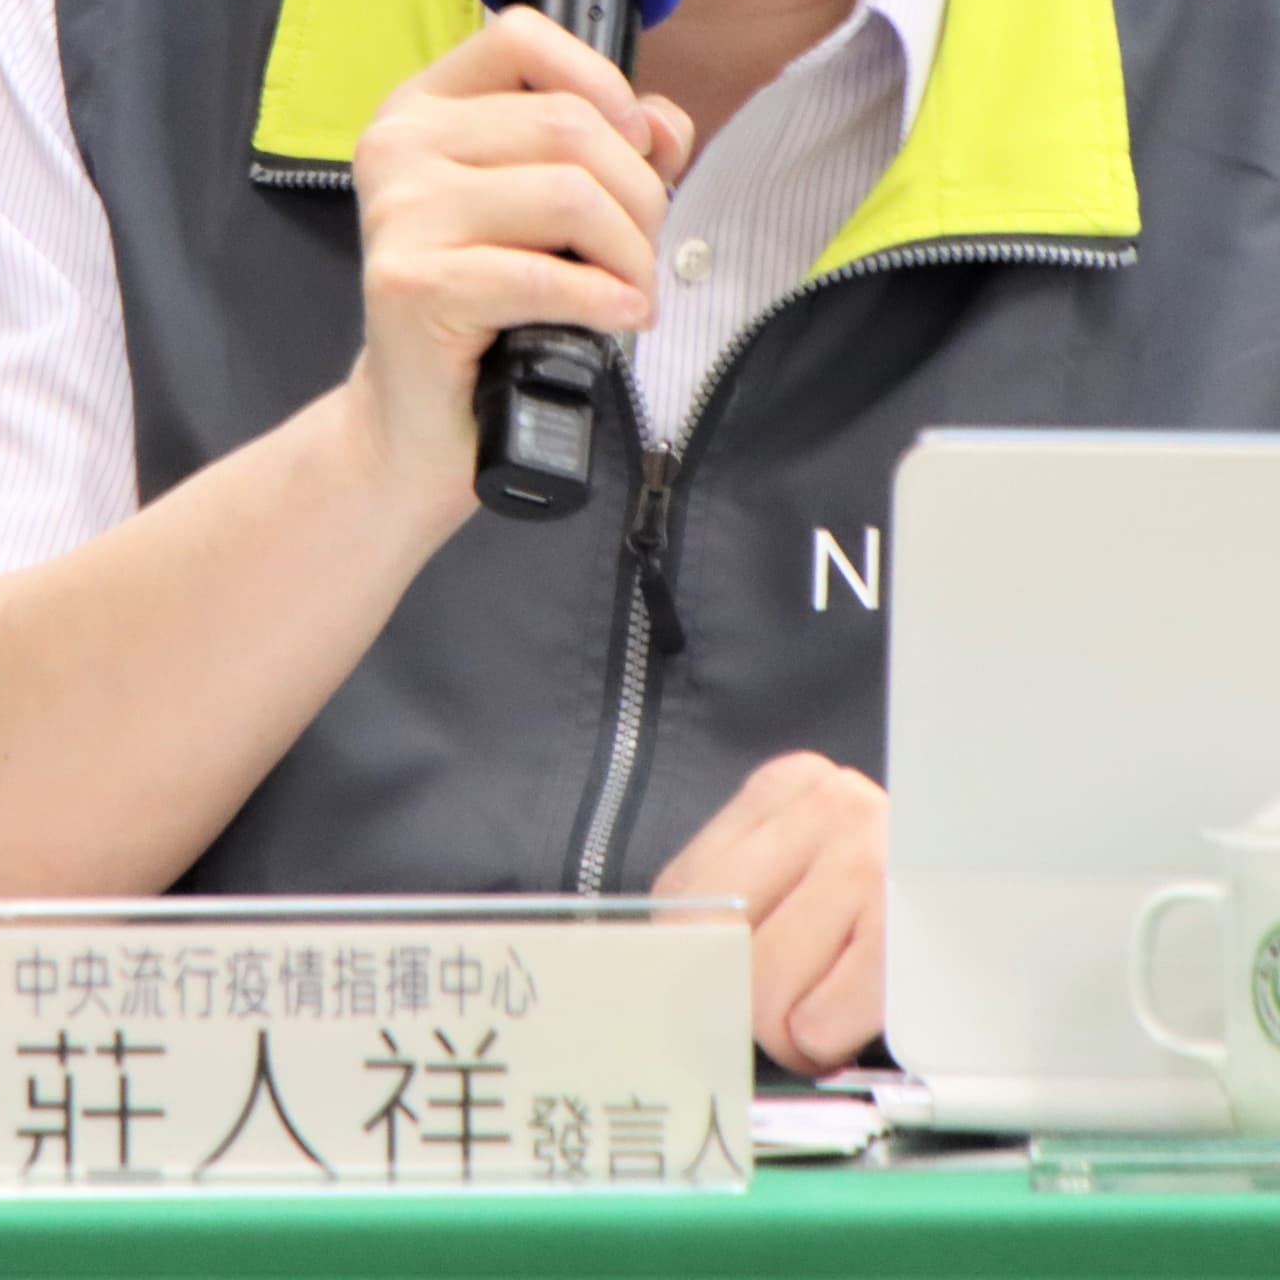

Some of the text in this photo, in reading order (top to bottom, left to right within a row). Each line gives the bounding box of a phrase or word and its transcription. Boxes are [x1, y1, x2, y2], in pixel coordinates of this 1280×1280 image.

[812, 526, 881, 611] N
[16, 946, 538, 1019] 中央流行疫情指揮中心
